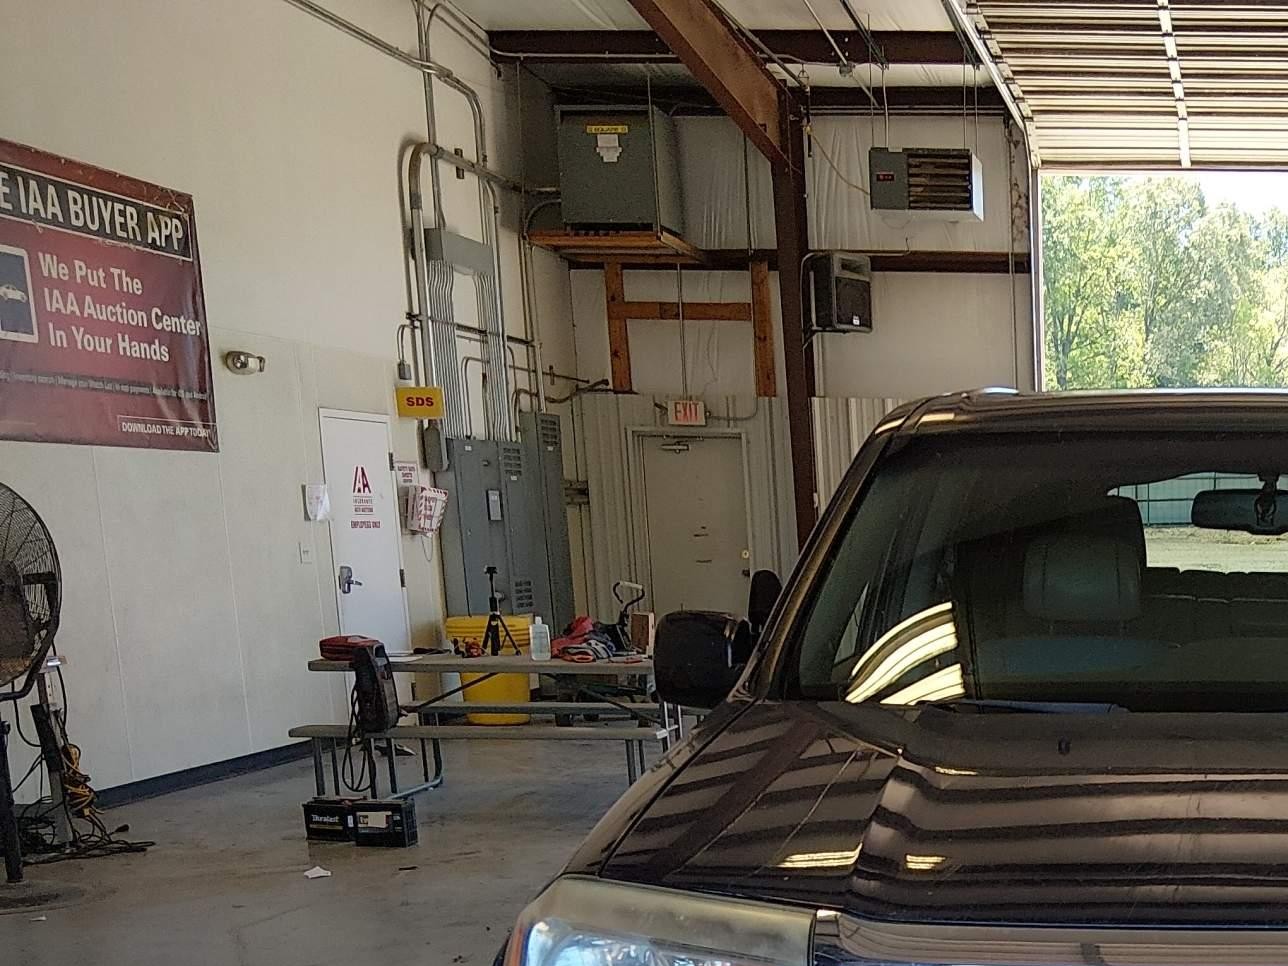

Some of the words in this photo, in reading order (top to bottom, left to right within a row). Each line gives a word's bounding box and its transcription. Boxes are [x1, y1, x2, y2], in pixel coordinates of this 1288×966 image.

[17, 175, 64, 223] IAA
[66, 189, 142, 242] BUYER
[147, 212, 183, 250] APP
[38, 252, 69, 281] We
[74, 259, 107, 288] Put
[110, 267, 143, 295] The
[44, 287, 80, 316] IAA
[83, 295, 148, 328] Auction
[151, 307, 201, 336] Center
[48, 322, 68, 348] In
[71, 326, 113, 354] Your
[117, 332, 170, 362] Hands
[406, 396, 434, 407] SDS
[674, 401, 699, 421] EXIT
[121, 421, 162, 434] DOWNLOAD
[162, 425, 174, 435] THE
[175, 426, 189, 436] APP
